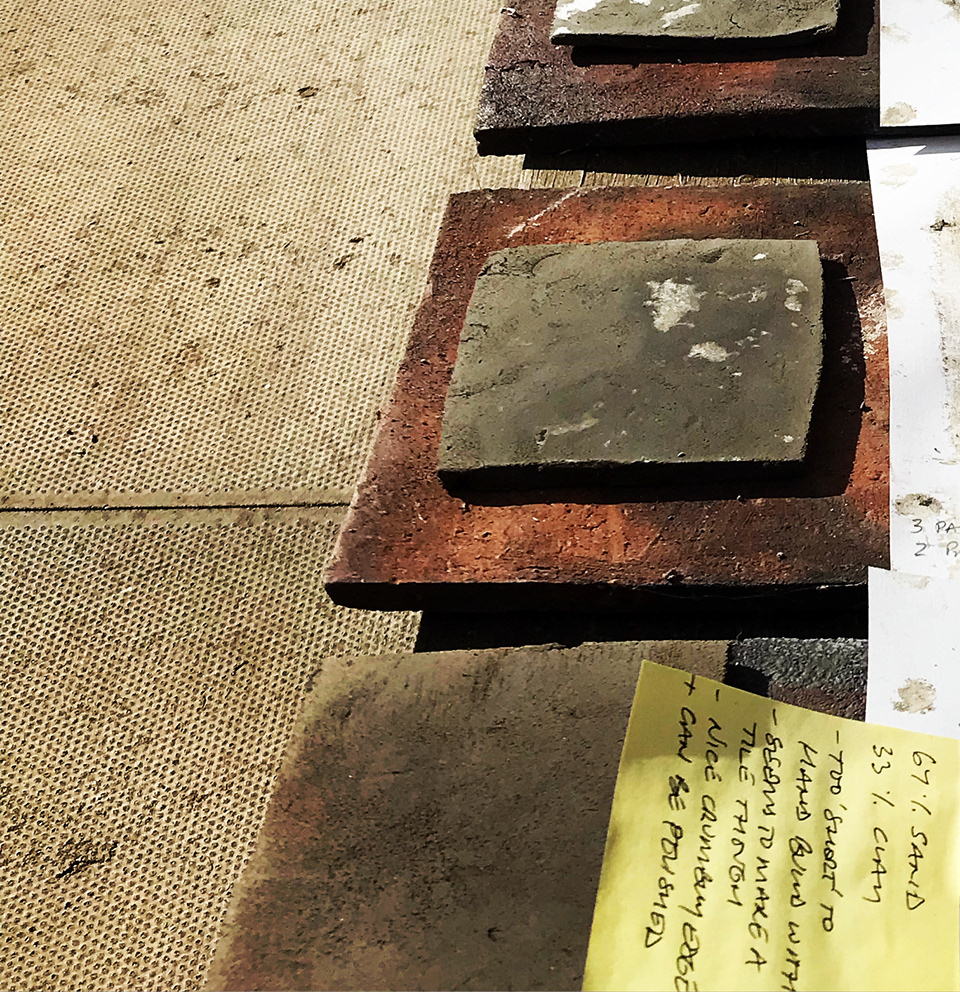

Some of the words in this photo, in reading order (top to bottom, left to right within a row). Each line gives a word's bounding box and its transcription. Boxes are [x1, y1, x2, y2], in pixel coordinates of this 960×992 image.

[910, 518, 923, 533] 3
[914, 543, 927, 557] 2
[677, 707, 697, 763] CAN
[705, 717, 728, 782] NICE
[739, 722, 757, 787] TILE
[668, 774, 690, 811] BE
[762, 733, 784, 816] SEEMS
[796, 740, 818, 821] HAND
[828, 750, 843, 795] TOO
[678, 794, 717, 917] CRUMBLY
[727, 799, 748, 907] THOUGH
[758, 826, 775, 849] TO
[862, 827, 889, 903] CLAY
[906, 826, 929, 910] SAND
[643, 820, 684, 948] POLISHED
[748, 856, 770, 944] MAKE
[788, 836, 813, 908] BUILD
[820, 902, 834, 932] TO
[744, 947, 767, 973] A
[781, 921, 801, 992] WITH
